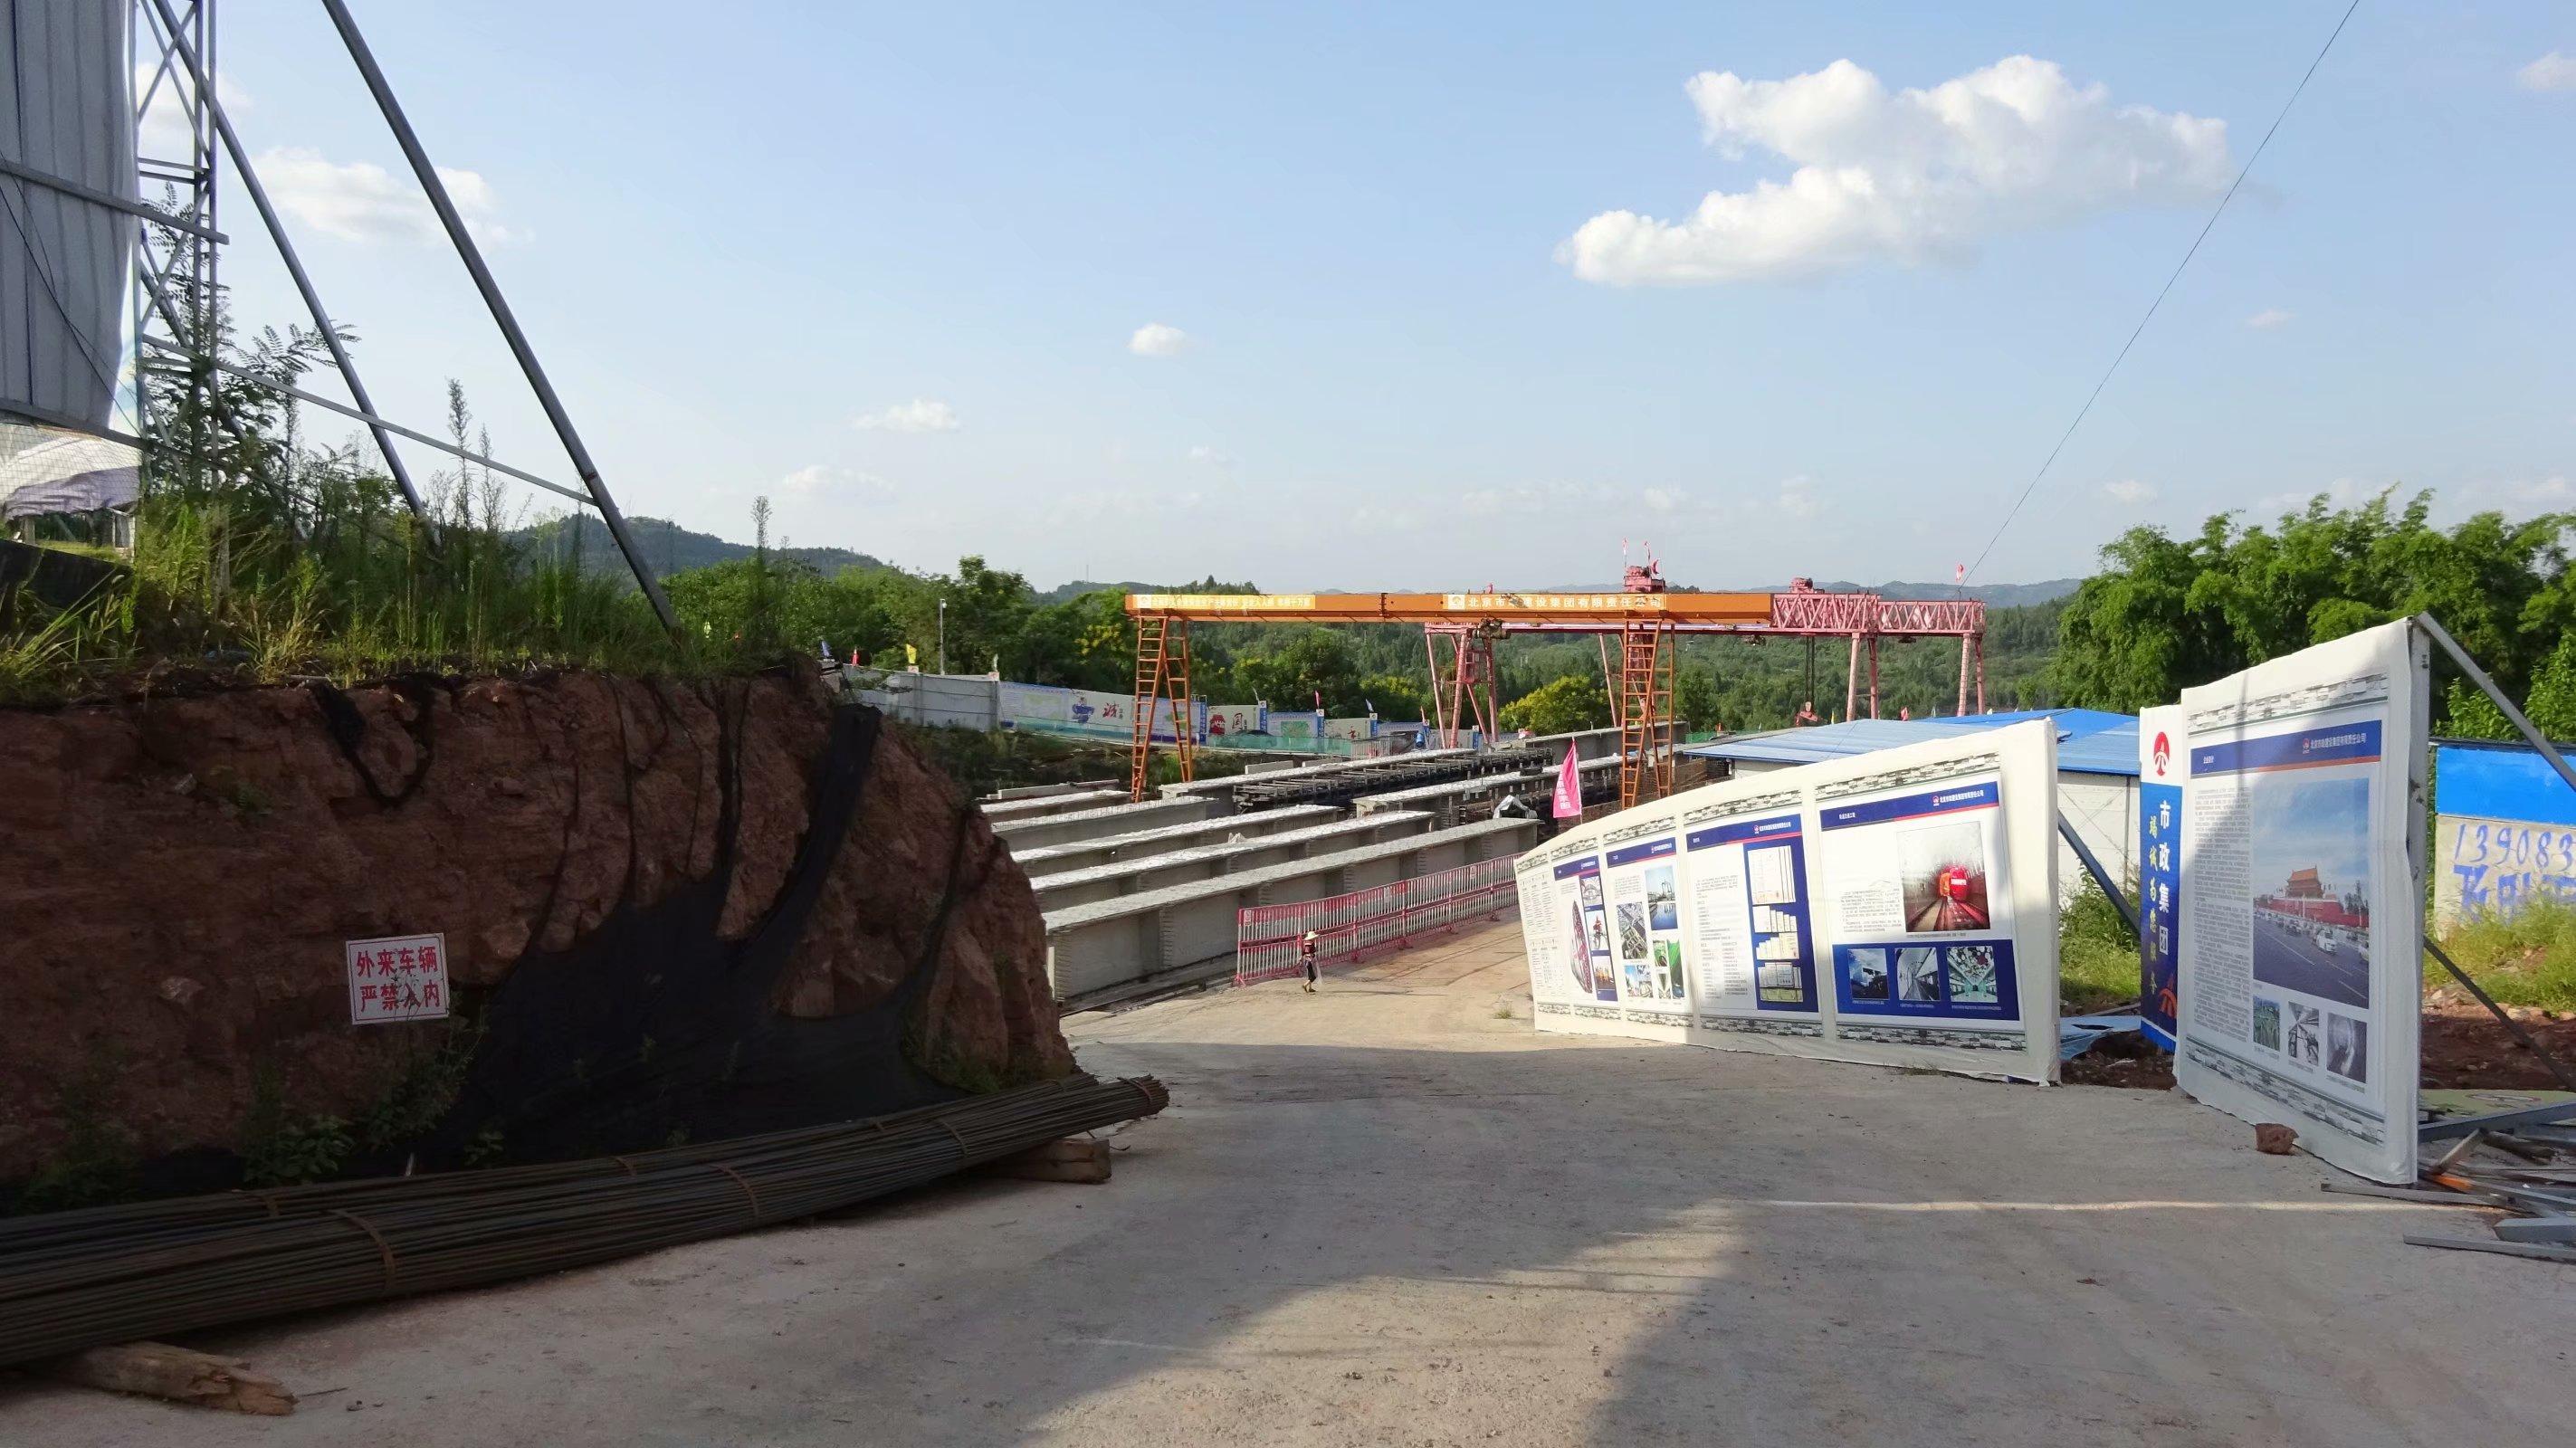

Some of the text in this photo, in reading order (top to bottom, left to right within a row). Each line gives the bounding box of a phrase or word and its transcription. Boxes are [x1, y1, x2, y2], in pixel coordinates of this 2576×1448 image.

[2159, 800, 2171, 956] 市政集团
[357, 946, 438, 977] 外来车辆
[360, 979, 440, 1012] 严禁入内
